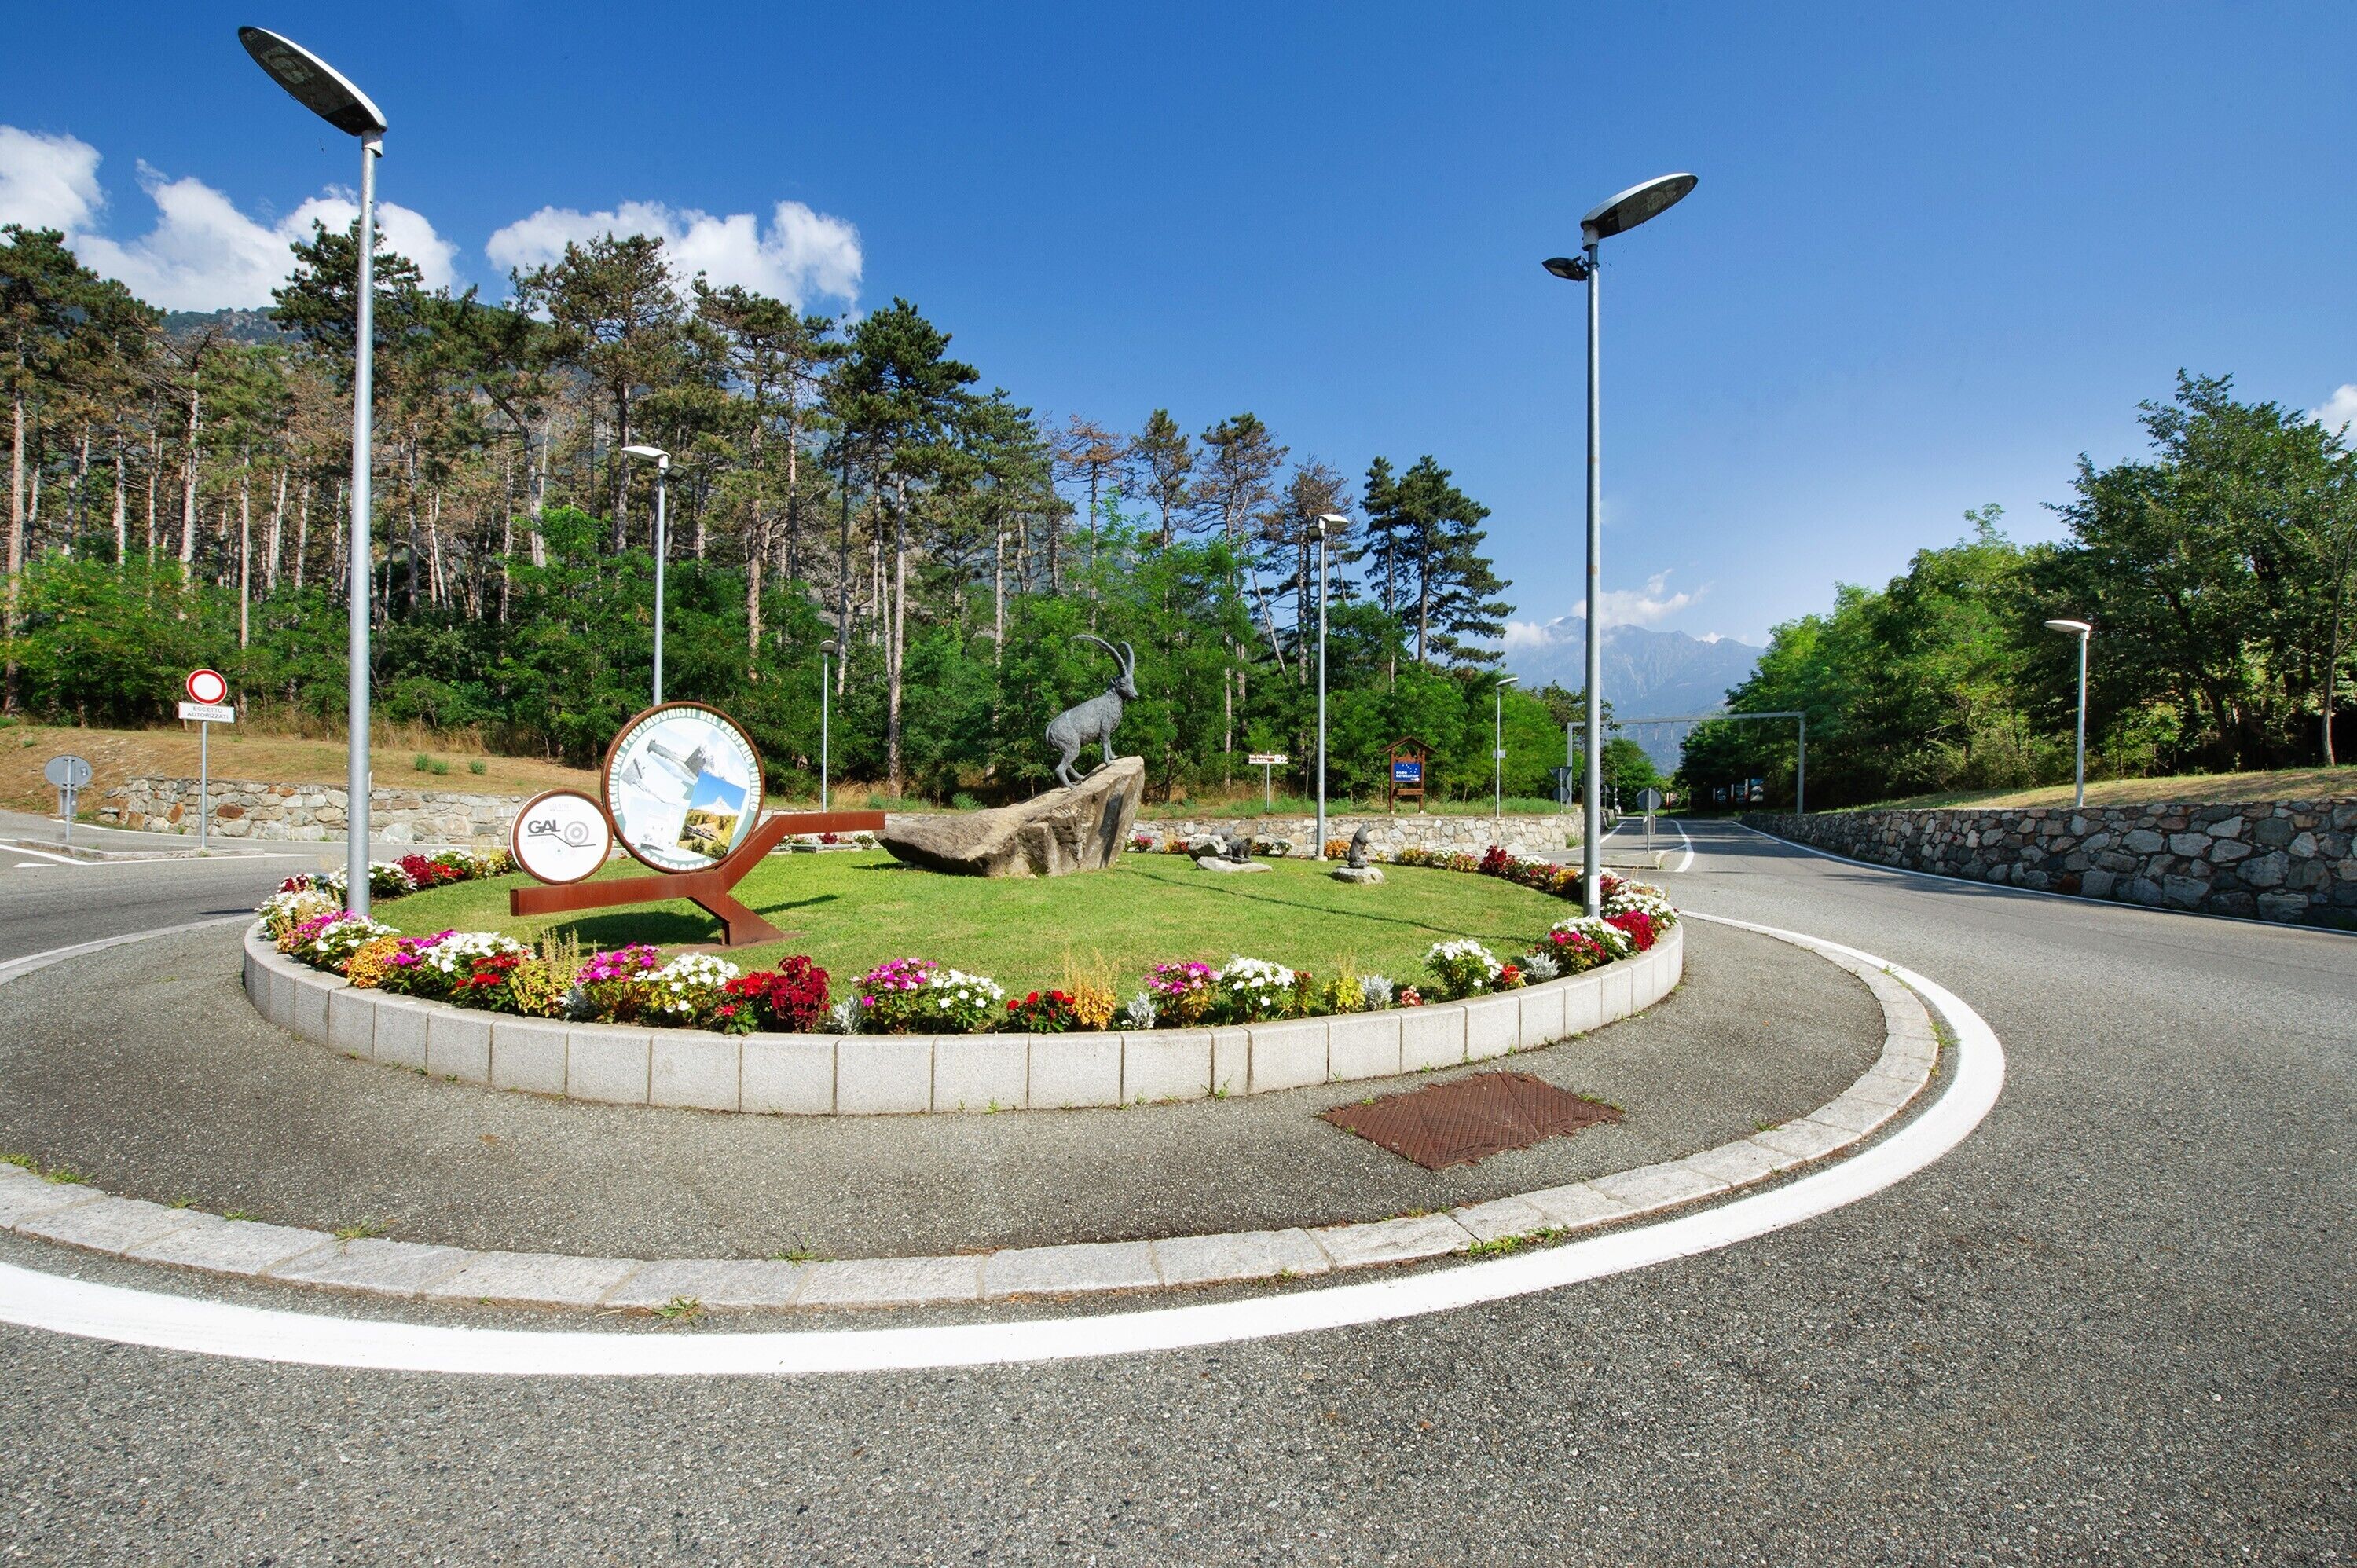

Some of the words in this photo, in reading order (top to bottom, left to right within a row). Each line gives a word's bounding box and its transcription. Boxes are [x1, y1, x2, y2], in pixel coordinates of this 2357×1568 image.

[609, 749, 627, 816] TERRITORI
[620, 708, 697, 750] PROTAGONISTI
[699, 709, 718, 726] DEL
[719, 720, 757, 765] PROPRIO
[749, 765, 761, 812] FUTURO
[527, 819, 561, 834] GAL
